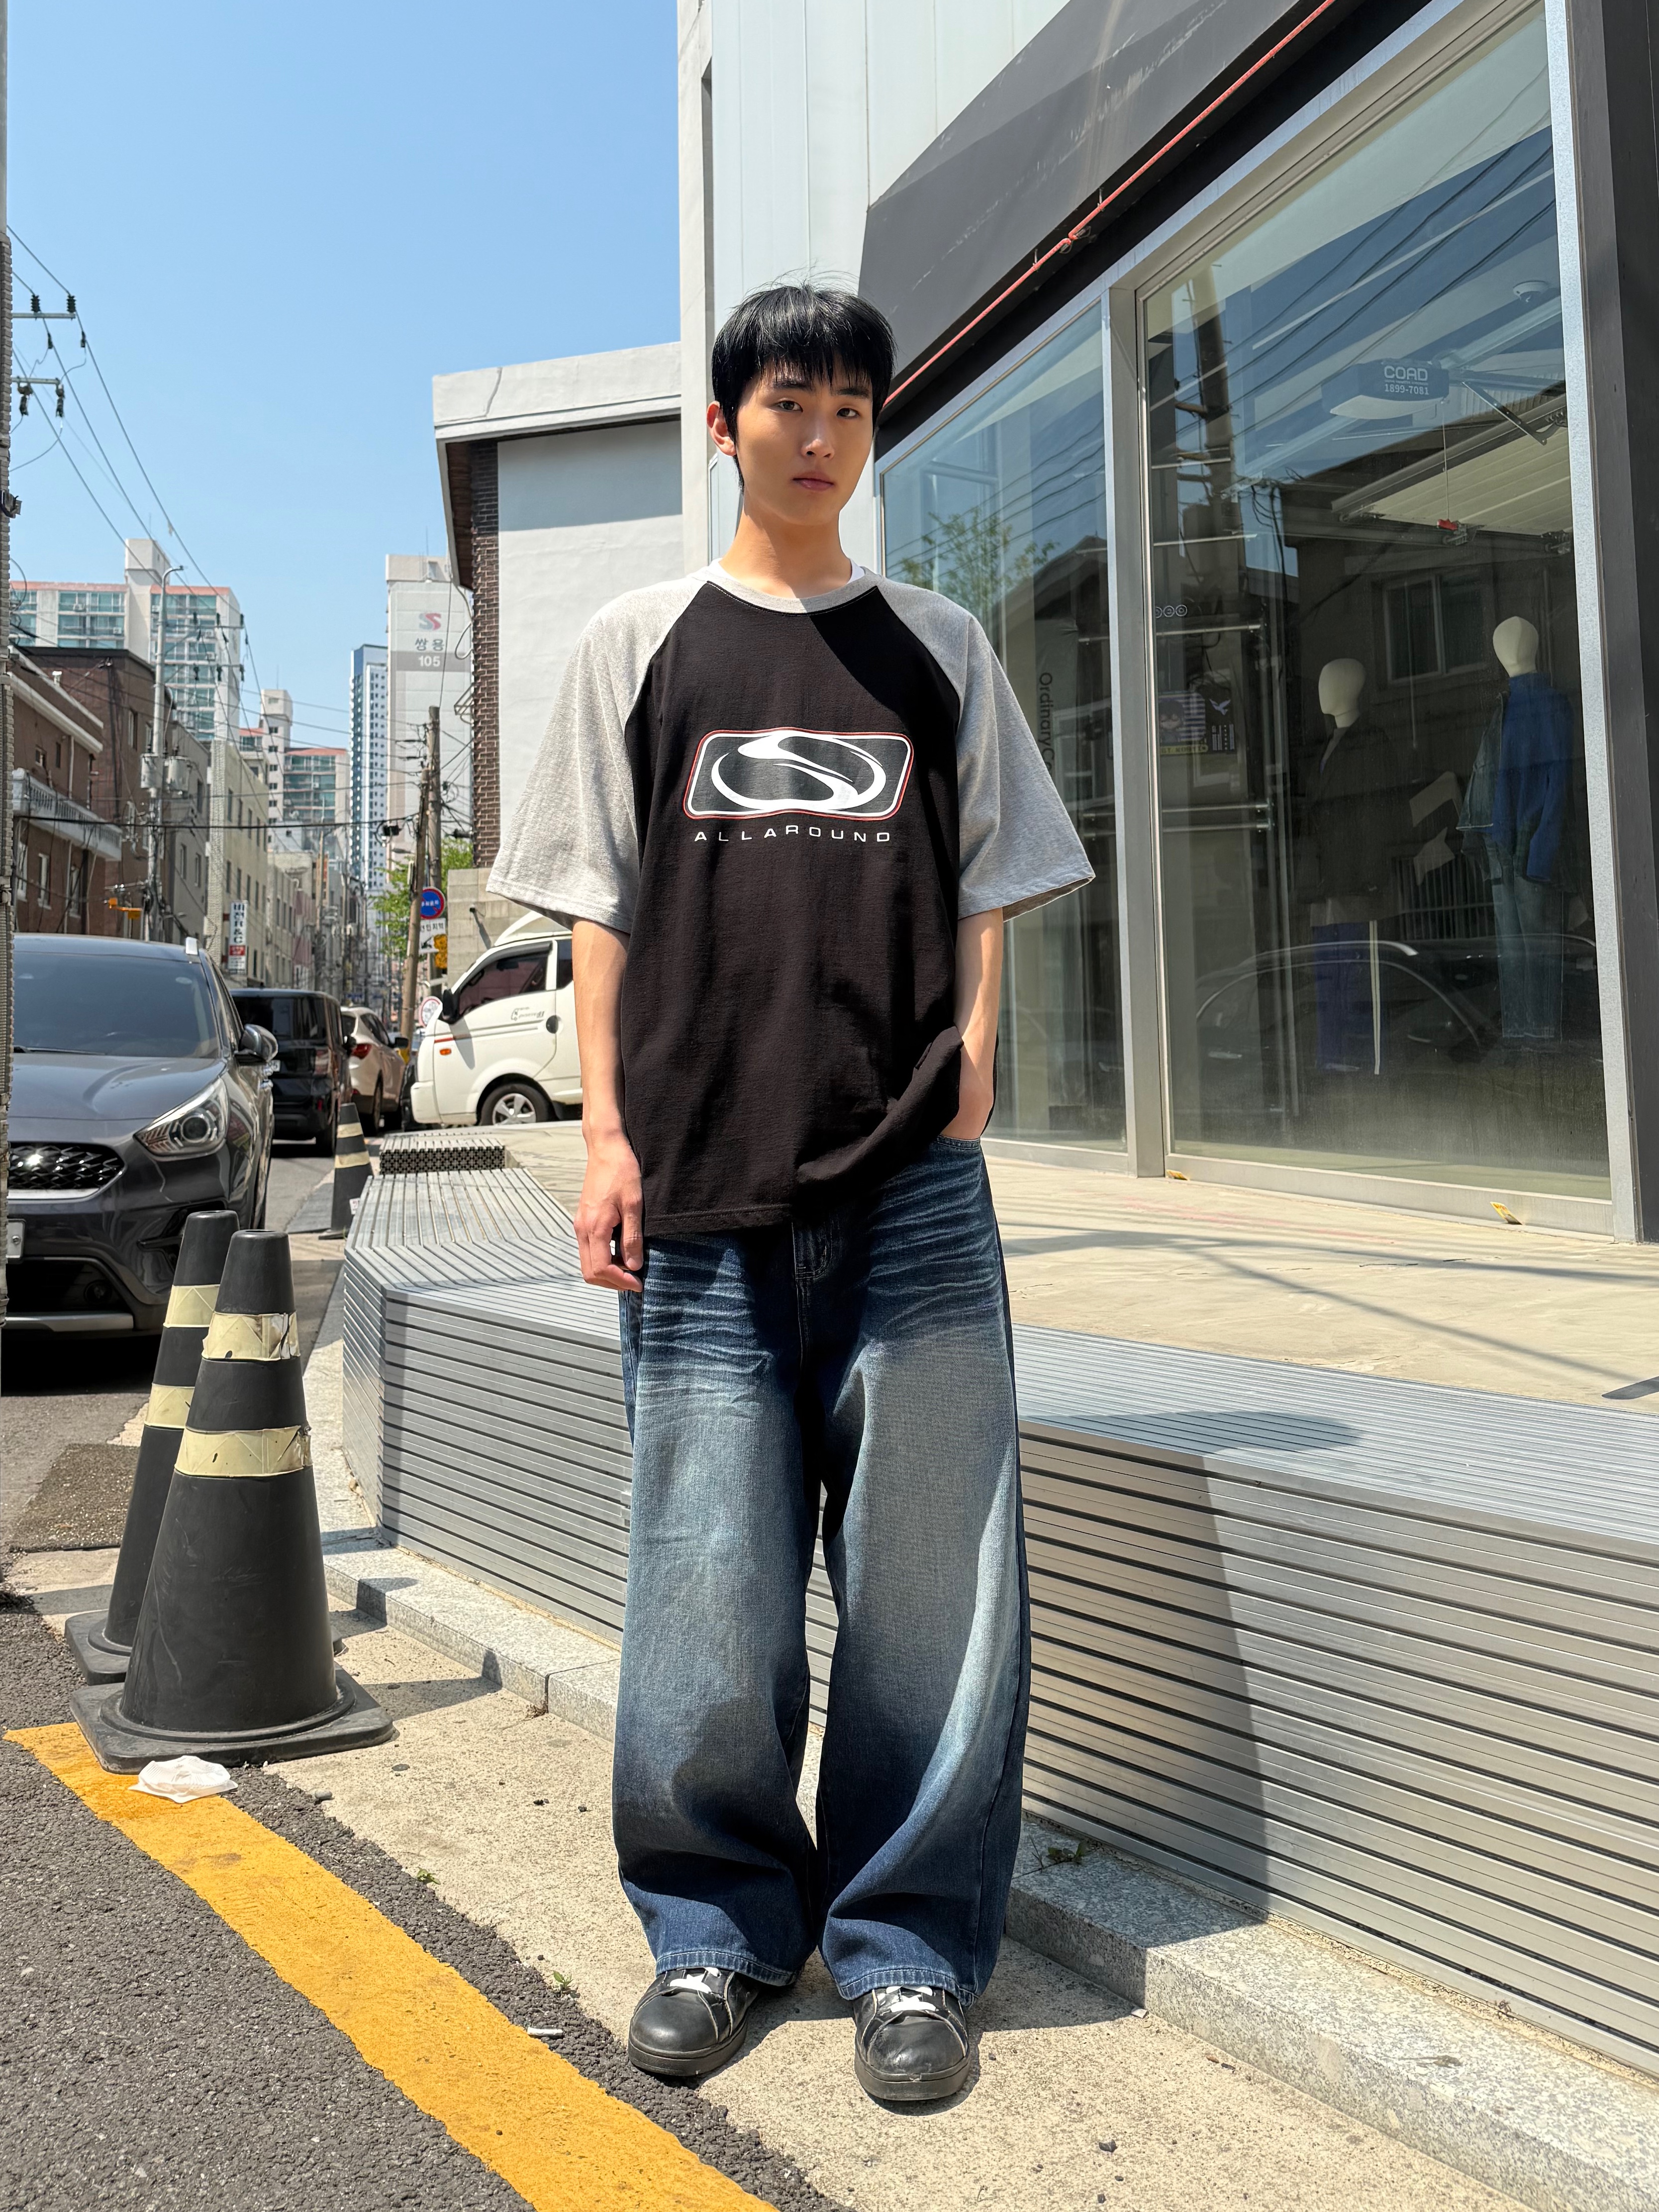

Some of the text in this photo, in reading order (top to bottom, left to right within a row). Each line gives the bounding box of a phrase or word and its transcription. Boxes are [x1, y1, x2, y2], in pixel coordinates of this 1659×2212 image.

[1384, 366, 1428, 381] COAD
[1385, 384, 1429, 395] 1899-7081
[415, 638, 444, 652] 쌍용
[418, 656, 440, 667] 105
[694, 825, 890, 842] ALLAROUND
